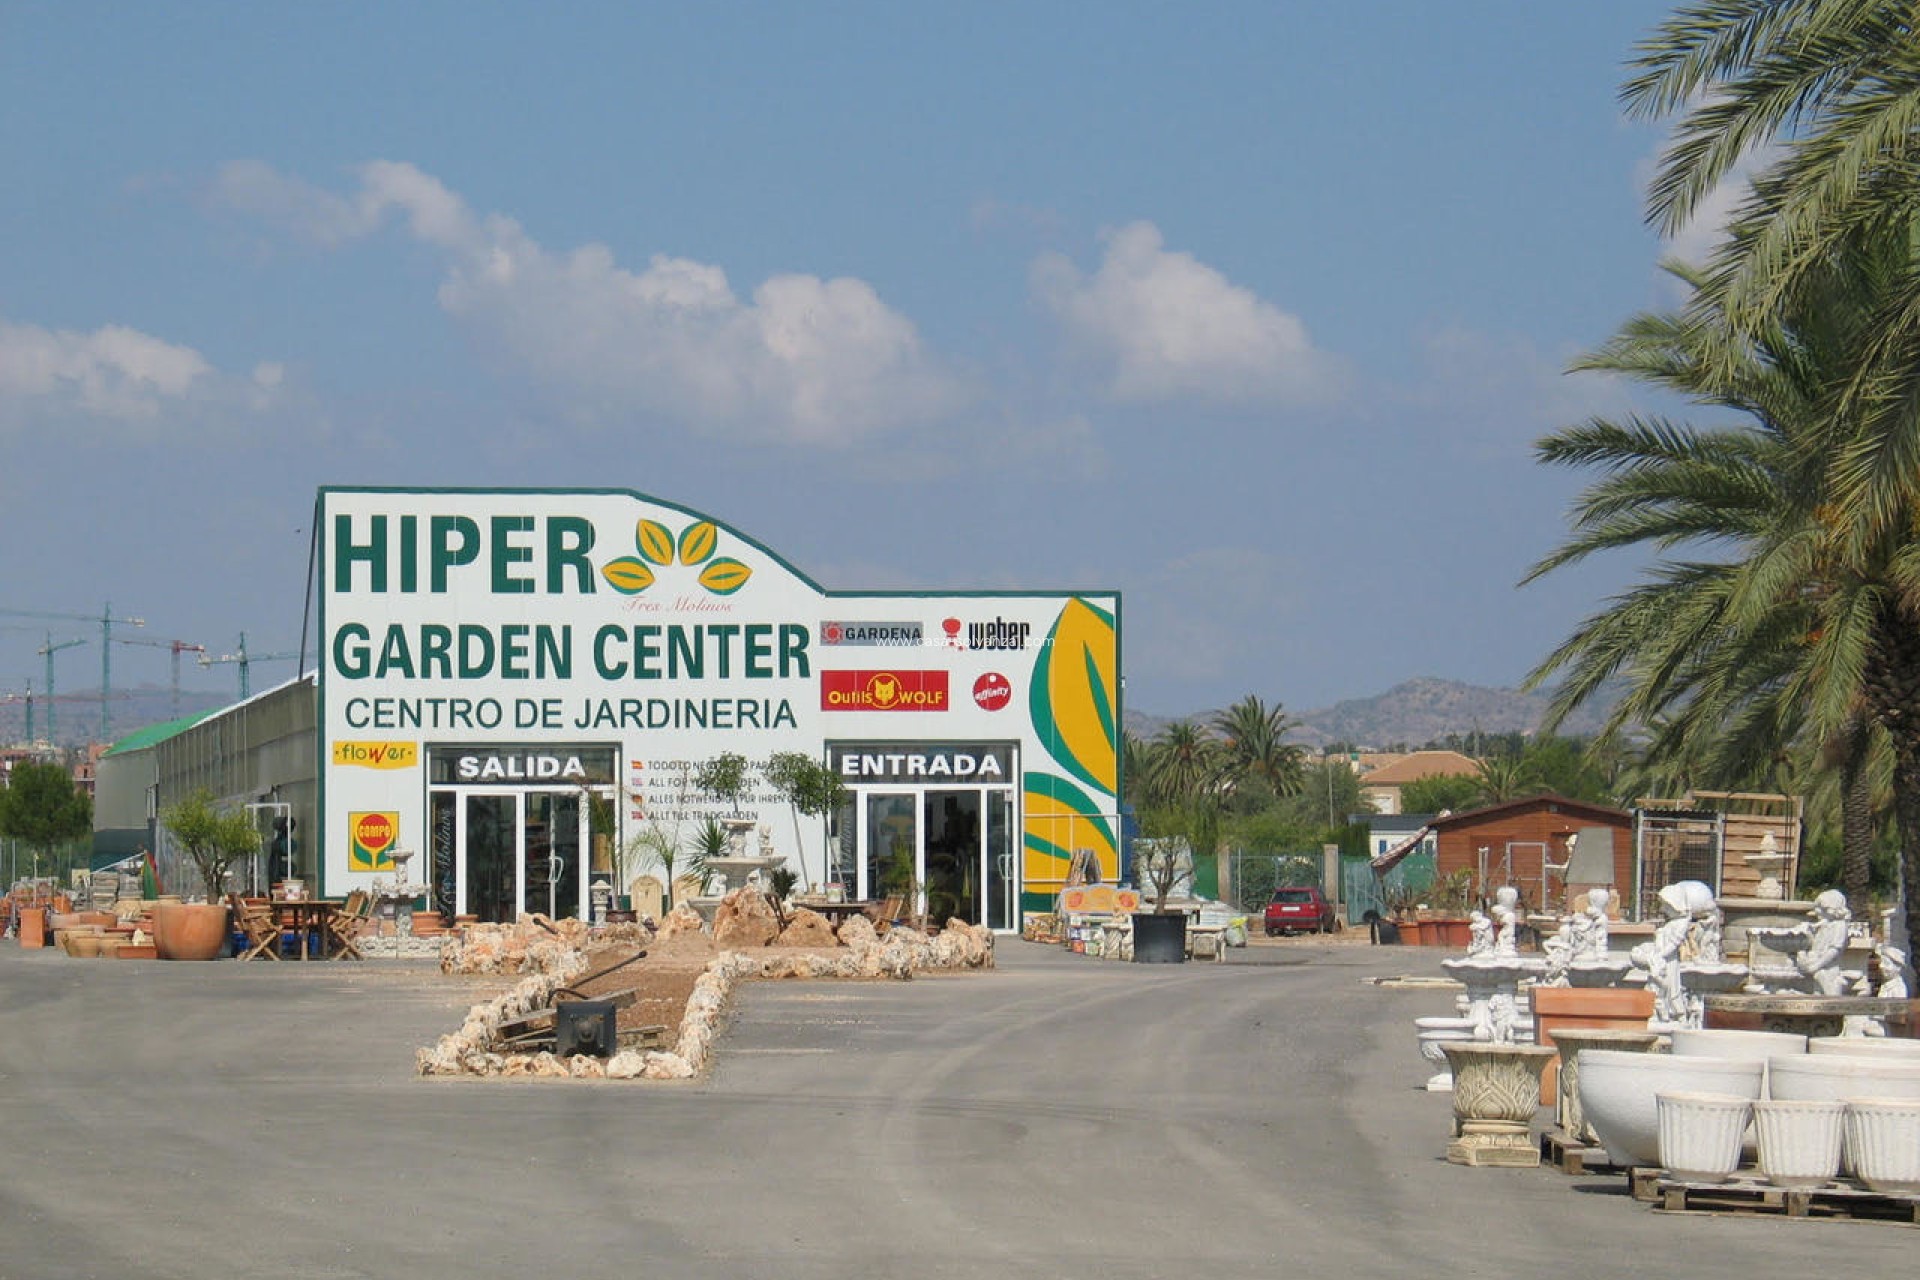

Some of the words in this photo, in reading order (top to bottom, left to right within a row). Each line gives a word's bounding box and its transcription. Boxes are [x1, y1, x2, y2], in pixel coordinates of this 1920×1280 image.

[334, 515, 597, 593] HIPER
[667, 595, 732, 613] Molinos
[845, 626, 922, 641] GARDENA
[967, 616, 1030, 651] weber
[333, 623, 572, 680] GARDEN
[593, 623, 811, 680] CENTER
[828, 690, 873, 704] Outils
[898, 691, 943, 704] WOLF
[345, 697, 503, 729] CENTRO
[515, 698, 564, 728] DE
[575, 697, 797, 729] JARDINERIA
[458, 755, 586, 778] SALIDA
[842, 754, 1002, 776] ENTRADA
[649, 777, 665, 787] ALL
